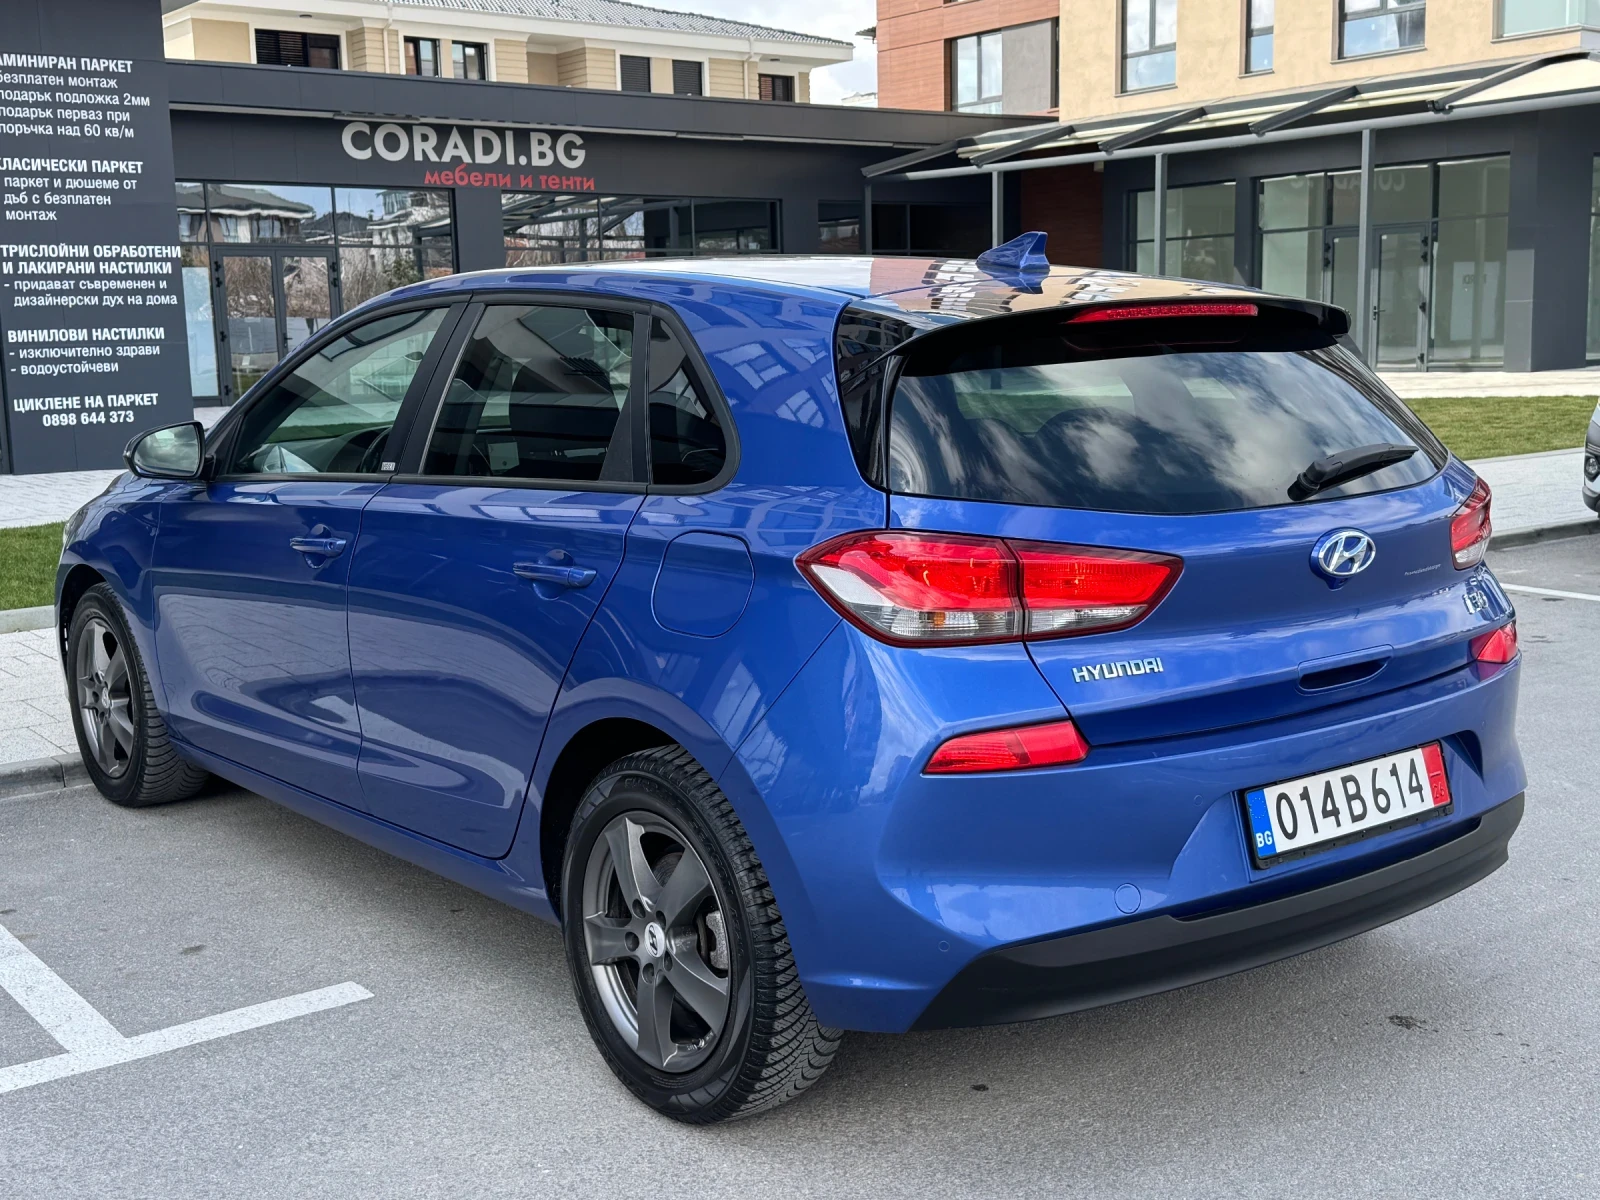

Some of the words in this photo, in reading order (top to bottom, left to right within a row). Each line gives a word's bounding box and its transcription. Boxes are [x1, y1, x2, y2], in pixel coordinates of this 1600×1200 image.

[81, 57, 133, 74] ПАРКЕТ
[68, 75, 118, 89] монтаж
[55, 92, 120, 106] подложка
[123, 93, 150, 107] 2мм
[0, 106, 53, 121] подарък
[57, 109, 103, 123] перваз
[107, 111, 130, 124] при
[0, 123, 53, 137] поръчка
[57, 124, 81, 137] над
[84, 124, 100, 137] 60
[104, 125, 134, 139] кв/м
[342, 122, 585, 168] CORADI.BG
[0, 157, 87, 173] ЛАСИЧЕСКИ
[91, 160, 144, 174] ПАРКЕТ
[3, 176, 49, 190] паркет
[53, 178, 61, 188] и
[65, 178, 120, 190] дюшеме
[123, 179, 138, 189] от
[424, 164, 511, 188] мебели
[520, 175, 532, 188] и
[539, 176, 594, 190] тенти
[3, 191, 29, 205] дъб
[32, 193, 40, 204] с
[44, 191, 112, 206] безплатен
[5, 210, 57, 221] монтаж
[0, 243, 90, 258] ТРИСЛОЙНИ
[93, 245, 181, 258] ОБРАБОТЕНИ
[2, 261, 14, 275] И
[17, 261, 95, 275] ЛАКИРАНИ
[99, 261, 172, 275] НАСТИЛКИ
[13, 279, 75, 292] придават
[79, 279, 155, 292] съвременен
[159, 280, 167, 289] и
[13, 293, 99, 308] дизайнерски
[102, 294, 124, 308] дух
[127, 294, 142, 304] на
[145, 293, 178, 306] дома
[7, 329, 89, 343] ВИНИЛОВИ
[92, 327, 165, 341] НАСТИЛКИ
[19, 346, 113, 359] изключително
[115, 345, 160, 358] здрави
[20, 361, 119, 376] водоустойчеви
[13, 396, 81, 413] ЦИКЛЕНЕ
[84, 394, 105, 409] НА
[107, 392, 159, 407] ПАРКЕТ
[42, 412, 77, 427] 0898
[81, 411, 106, 425] 644
[109, 410, 135, 424] 373
[1073, 657, 1163, 683] HYUNDAI
[1276, 758, 1425, 840] 014B614
[1256, 830, 1273, 847] BG
